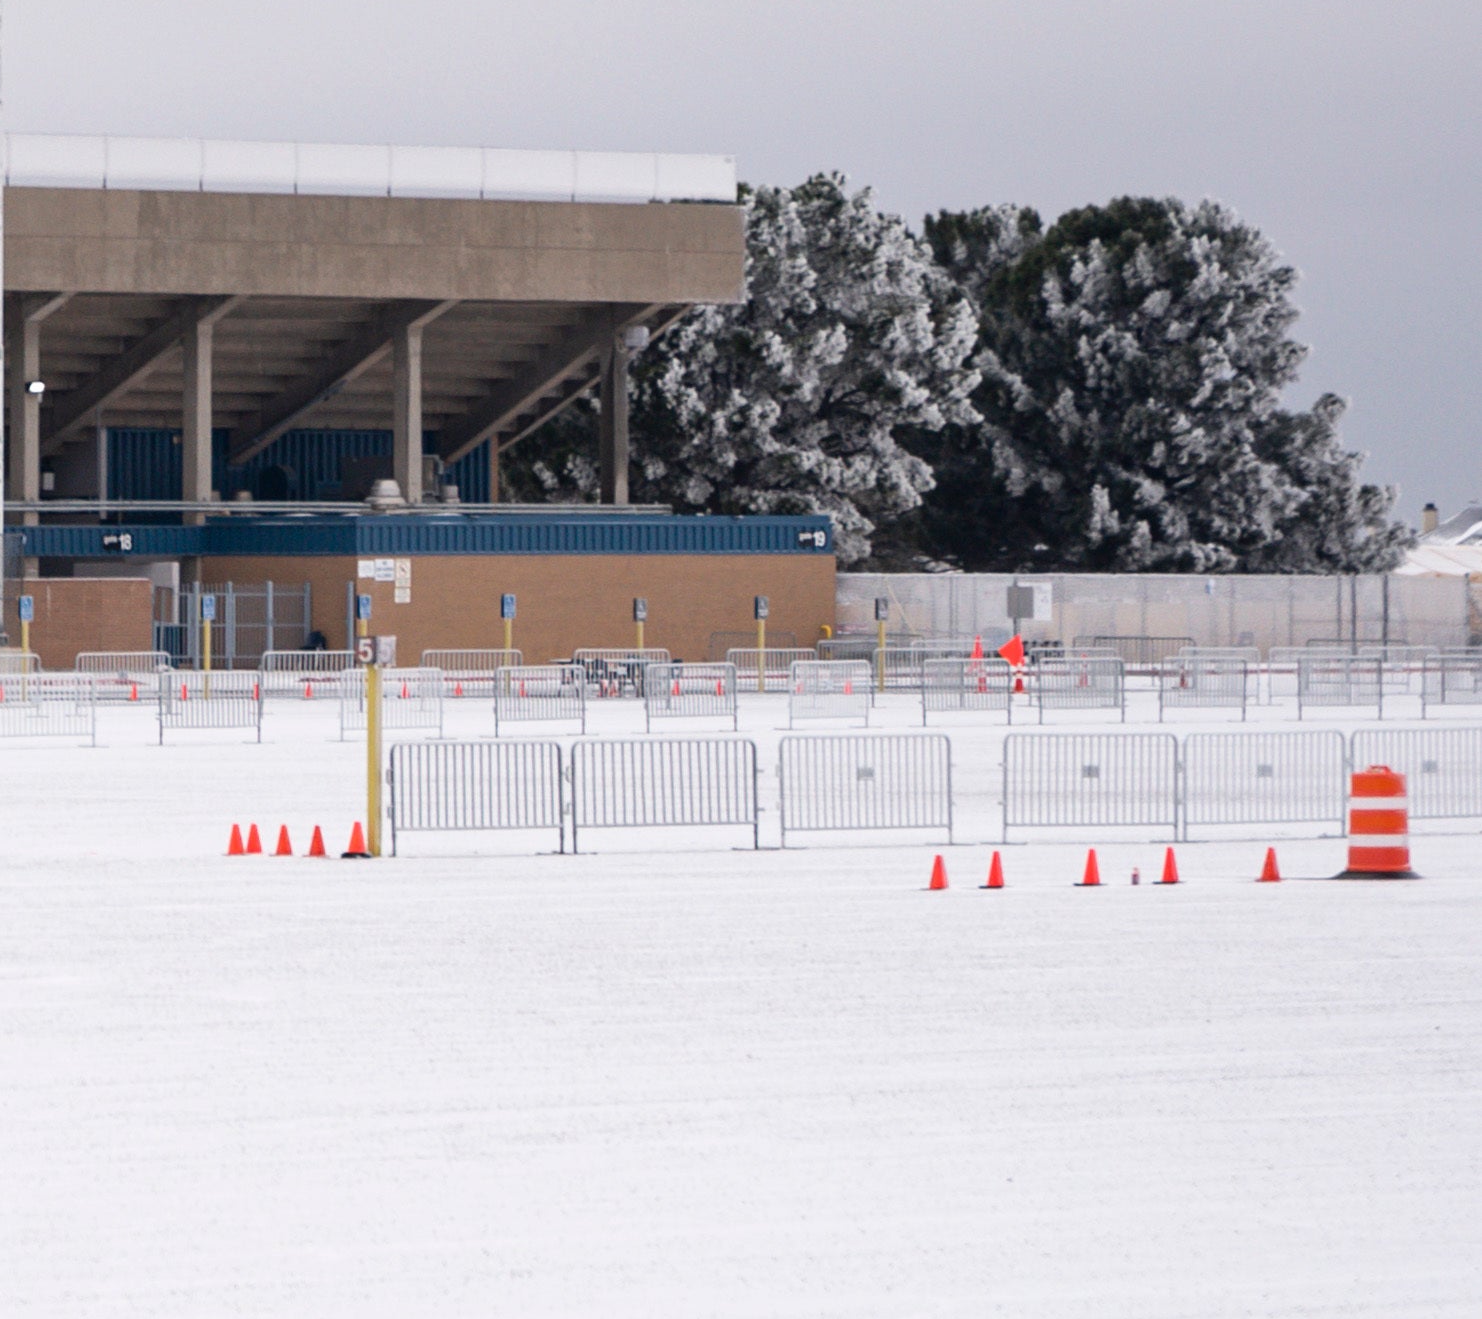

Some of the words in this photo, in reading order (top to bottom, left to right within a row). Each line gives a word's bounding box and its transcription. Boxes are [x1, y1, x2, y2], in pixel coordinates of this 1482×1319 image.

[119, 534, 132, 550] 18
[813, 531, 825, 547] 19
[359, 639, 373, 663] 5
